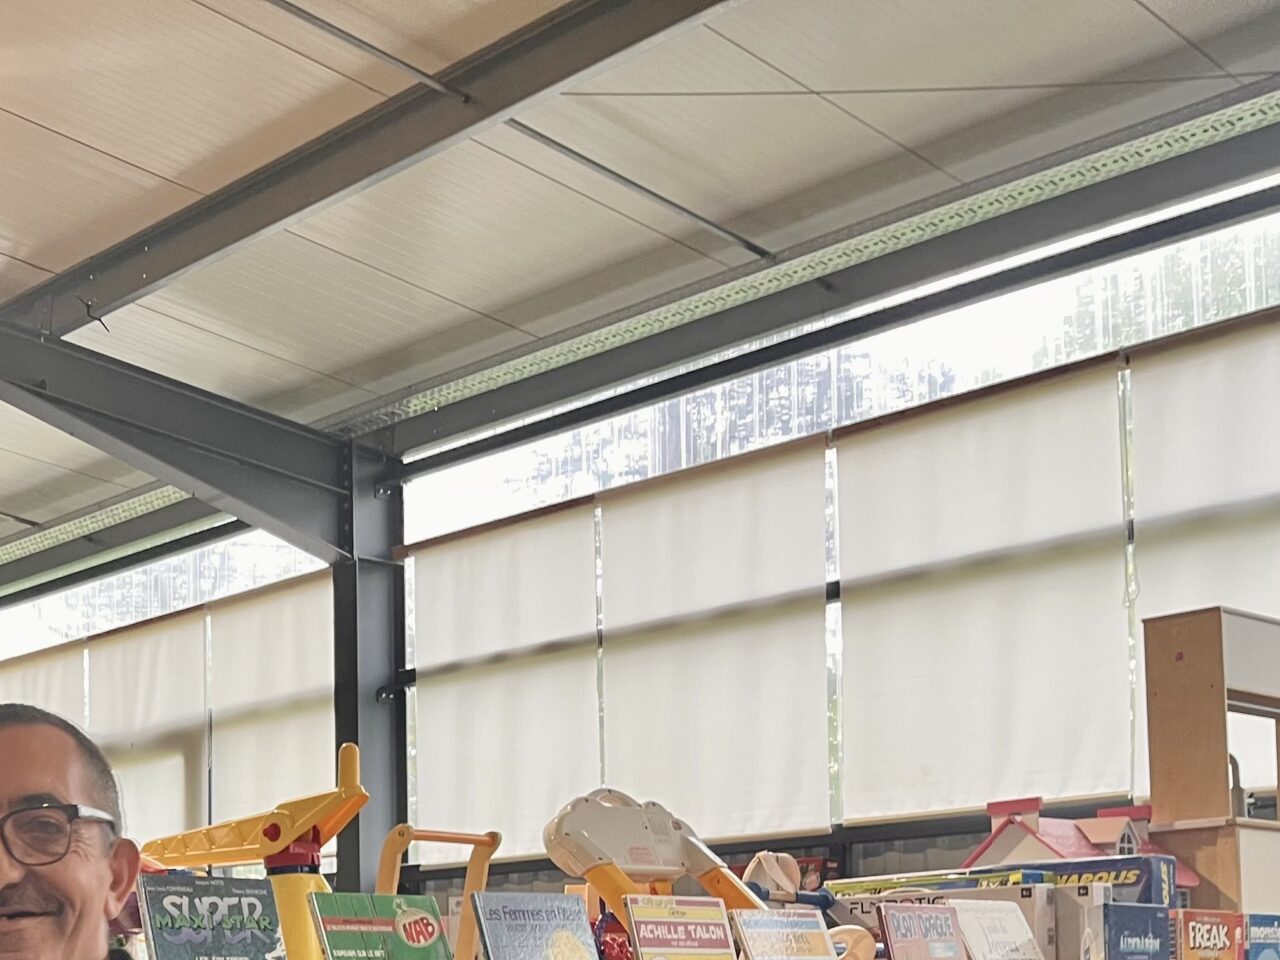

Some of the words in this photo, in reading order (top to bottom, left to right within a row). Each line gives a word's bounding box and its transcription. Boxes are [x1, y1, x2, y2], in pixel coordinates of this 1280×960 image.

[222, 914, 275, 931] STAR
[501, 905, 545, 923] Femmes
[639, 924, 686, 939] ACHILLE
[687, 925, 725, 940] TALON
[1188, 921, 1231, 949] FREAK
